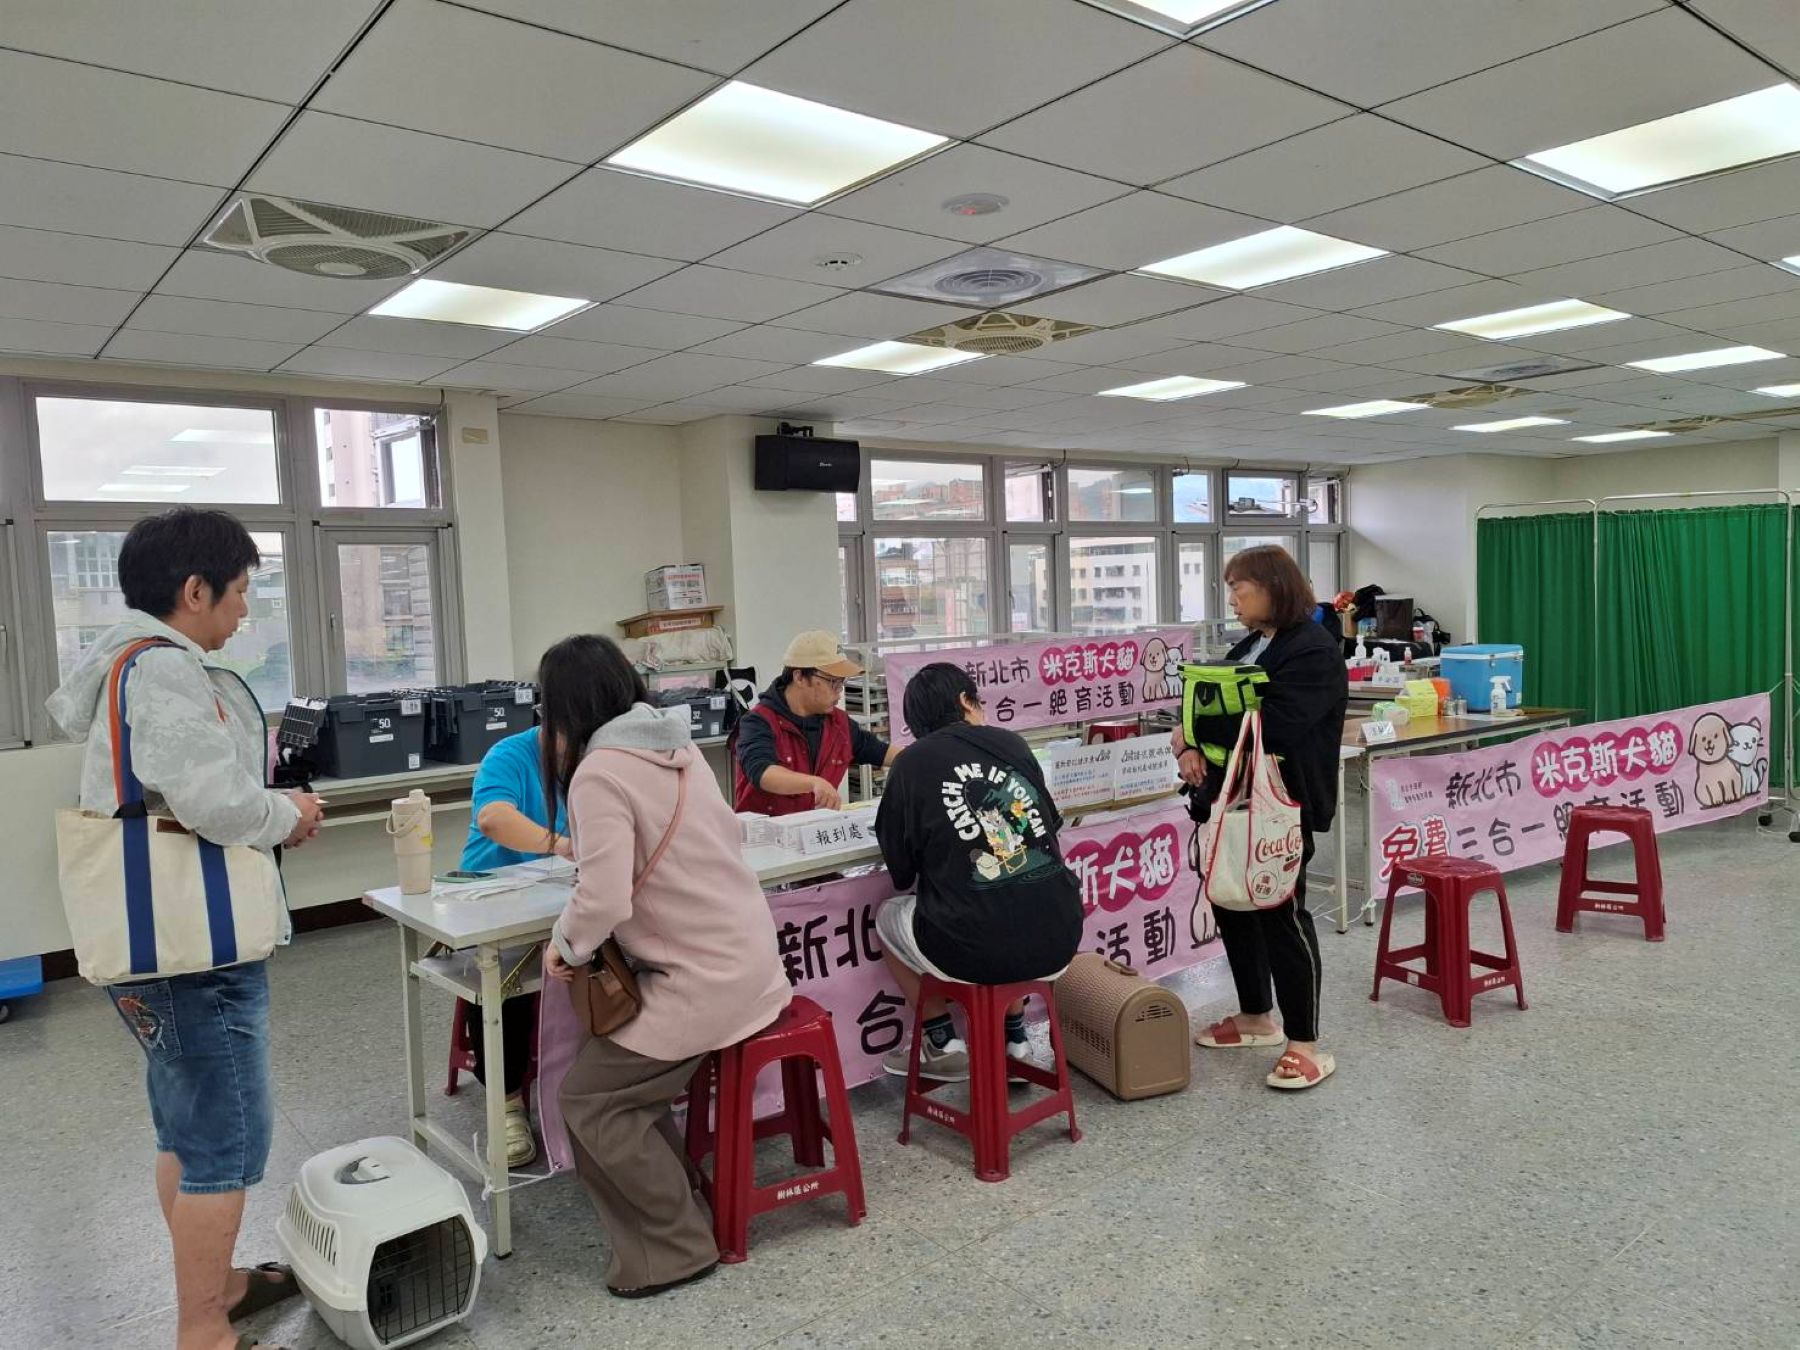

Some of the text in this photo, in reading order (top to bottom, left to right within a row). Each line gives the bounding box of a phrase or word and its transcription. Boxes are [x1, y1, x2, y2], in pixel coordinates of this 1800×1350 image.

[965, 644, 1137, 688] 新北市 米克斯犬貓
[494, 707, 505, 717] 50
[980, 681, 1135, 723] 合一絕育活動
[378, 717, 391, 729] 50
[953, 763, 984, 783] ME
[988, 765, 1007, 784] IF
[1445, 729, 1678, 810] 新北市 米克斯犬貓
[1007, 777, 1034, 808] YOU
[941, 781, 981, 841] CATCH
[1026, 808, 1047, 838] CAN
[815, 822, 864, 846] 報到處
[1096, 906, 1176, 967] 活動
